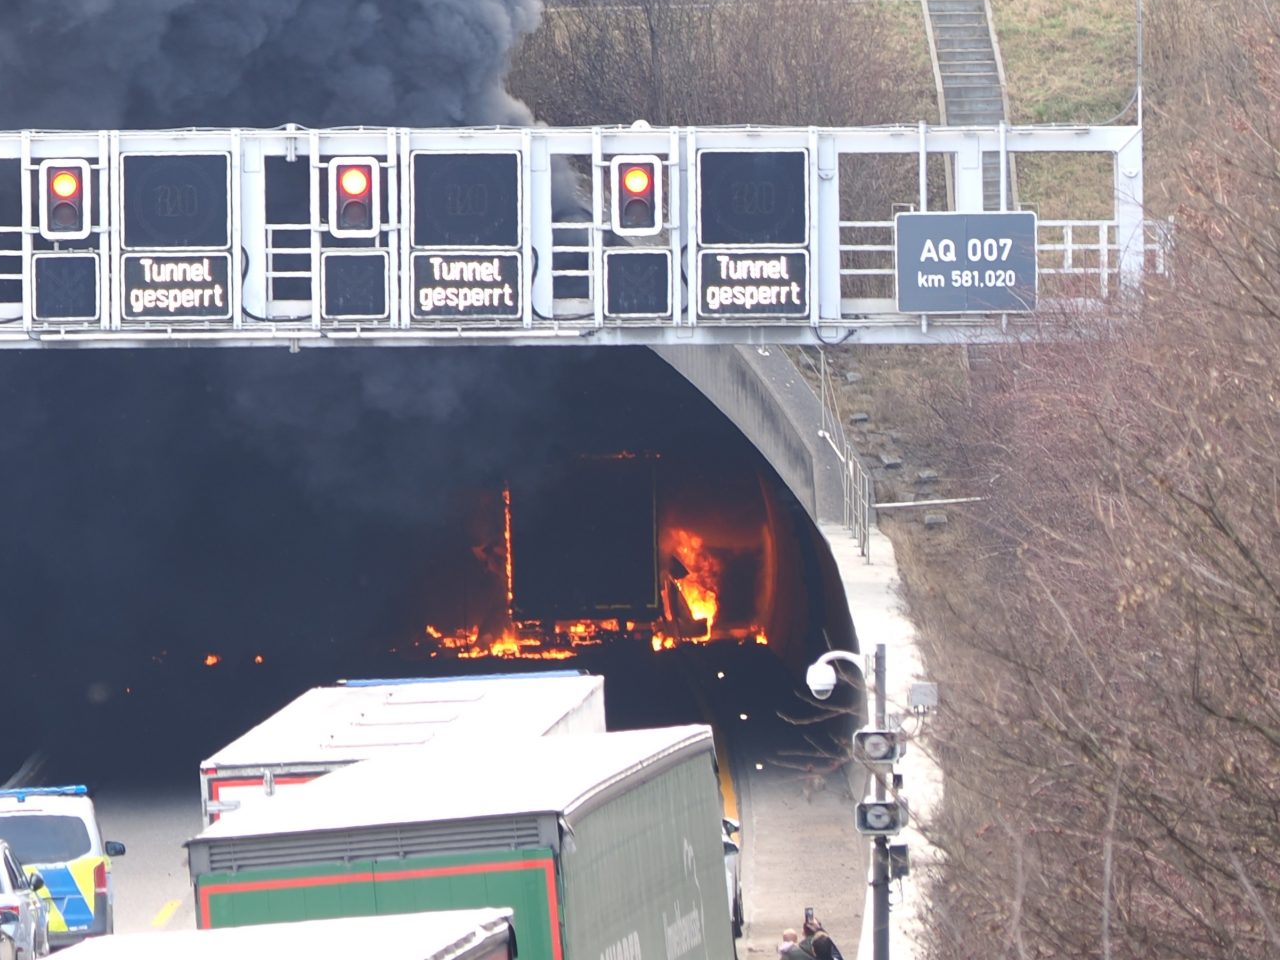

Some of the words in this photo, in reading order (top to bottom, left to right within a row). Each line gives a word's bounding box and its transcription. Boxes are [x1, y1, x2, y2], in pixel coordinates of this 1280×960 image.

[920, 238, 957, 263] AQ
[967, 238, 1013, 262] 007
[139, 258, 212, 283] Tunnel
[429, 257, 502, 282] Tunnel
[716, 255, 789, 280] Tunnel
[917, 270, 945, 288] km
[130, 284, 223, 313] gesperrt
[419, 283, 514, 311] gesperrt
[707, 281, 801, 310] gesperrt
